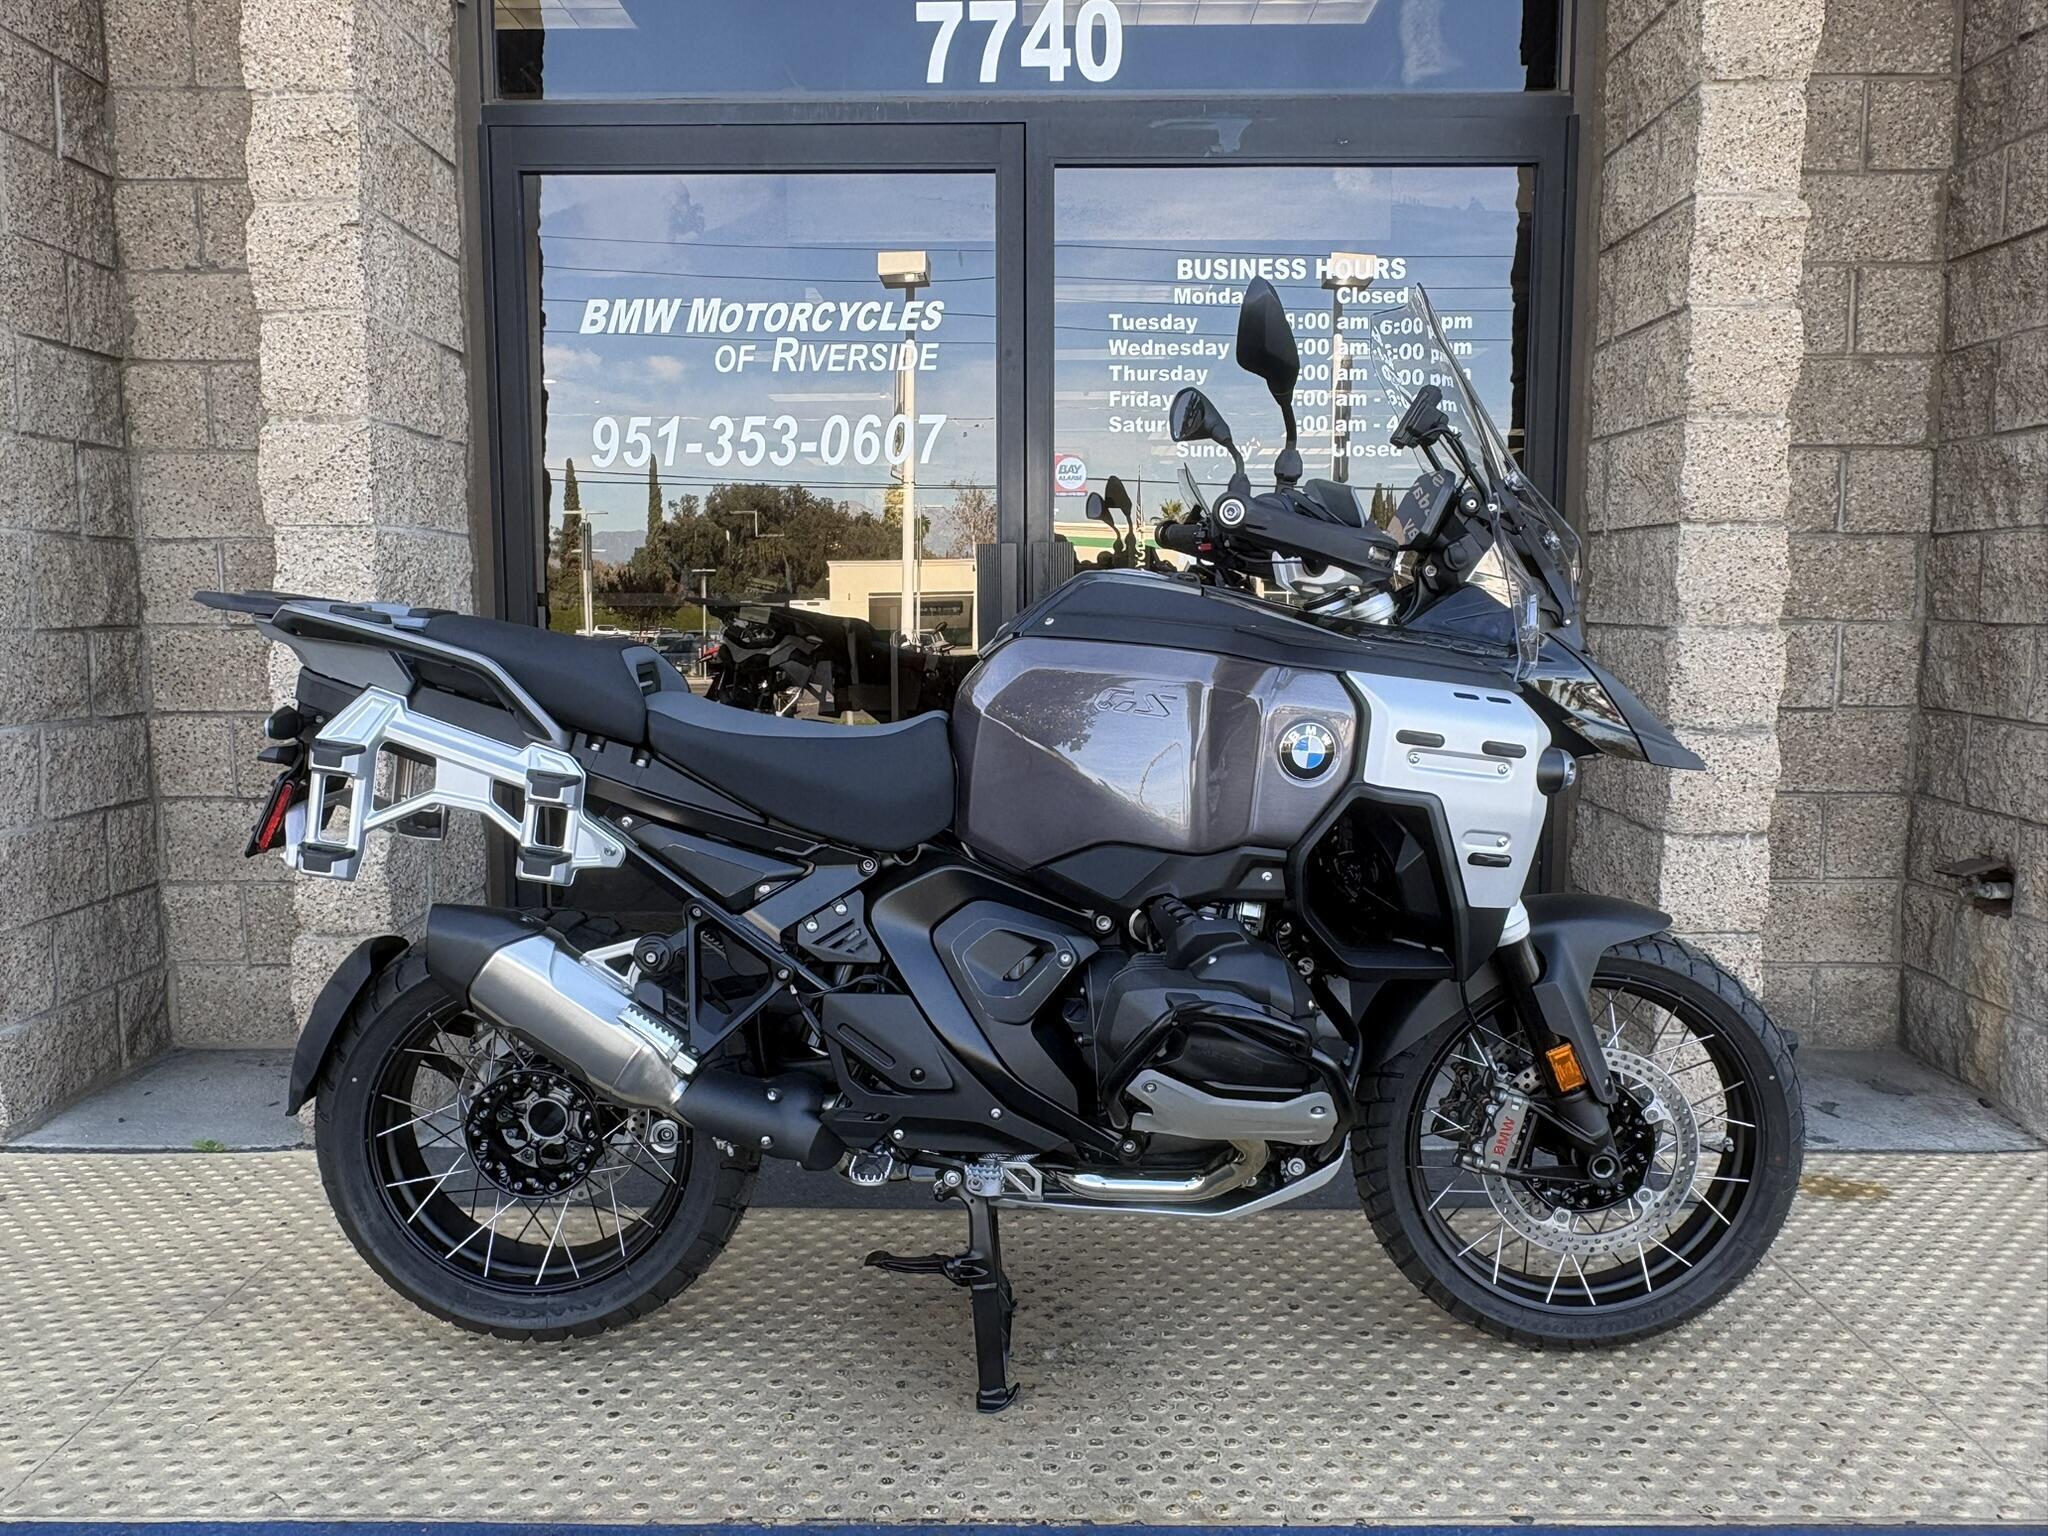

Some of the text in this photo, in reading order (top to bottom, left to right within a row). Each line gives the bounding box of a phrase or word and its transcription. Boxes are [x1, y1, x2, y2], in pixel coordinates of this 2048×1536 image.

[915, 0, 1123, 83] 7740
[1177, 257, 1407, 280] BUSINESS HOURS
[1174, 287, 1409, 305] Monda Closed
[579, 298, 945, 334] BMW MOTORCYCLES
[1108, 313, 1198, 334] Tuesday
[1336, 316, 1368, 329] am
[714, 337, 939, 373] OF RIVERSIDE
[1108, 339, 1230, 359] Wednesday
[1336, 342, 1368, 355] am
[1108, 365, 1208, 385] Thursday
[1337, 367, 1368, 381] am
[1109, 391, 1175, 411] Friday
[1336, 393, 1367, 406] am
[1335, 419, 1366, 432] am
[591, 414, 947, 467] 951-353-0607
[1058, 464, 1081, 474] BAY
[1288, 725, 1332, 746] BMW
[1493, 1115, 1515, 1157] BMW
